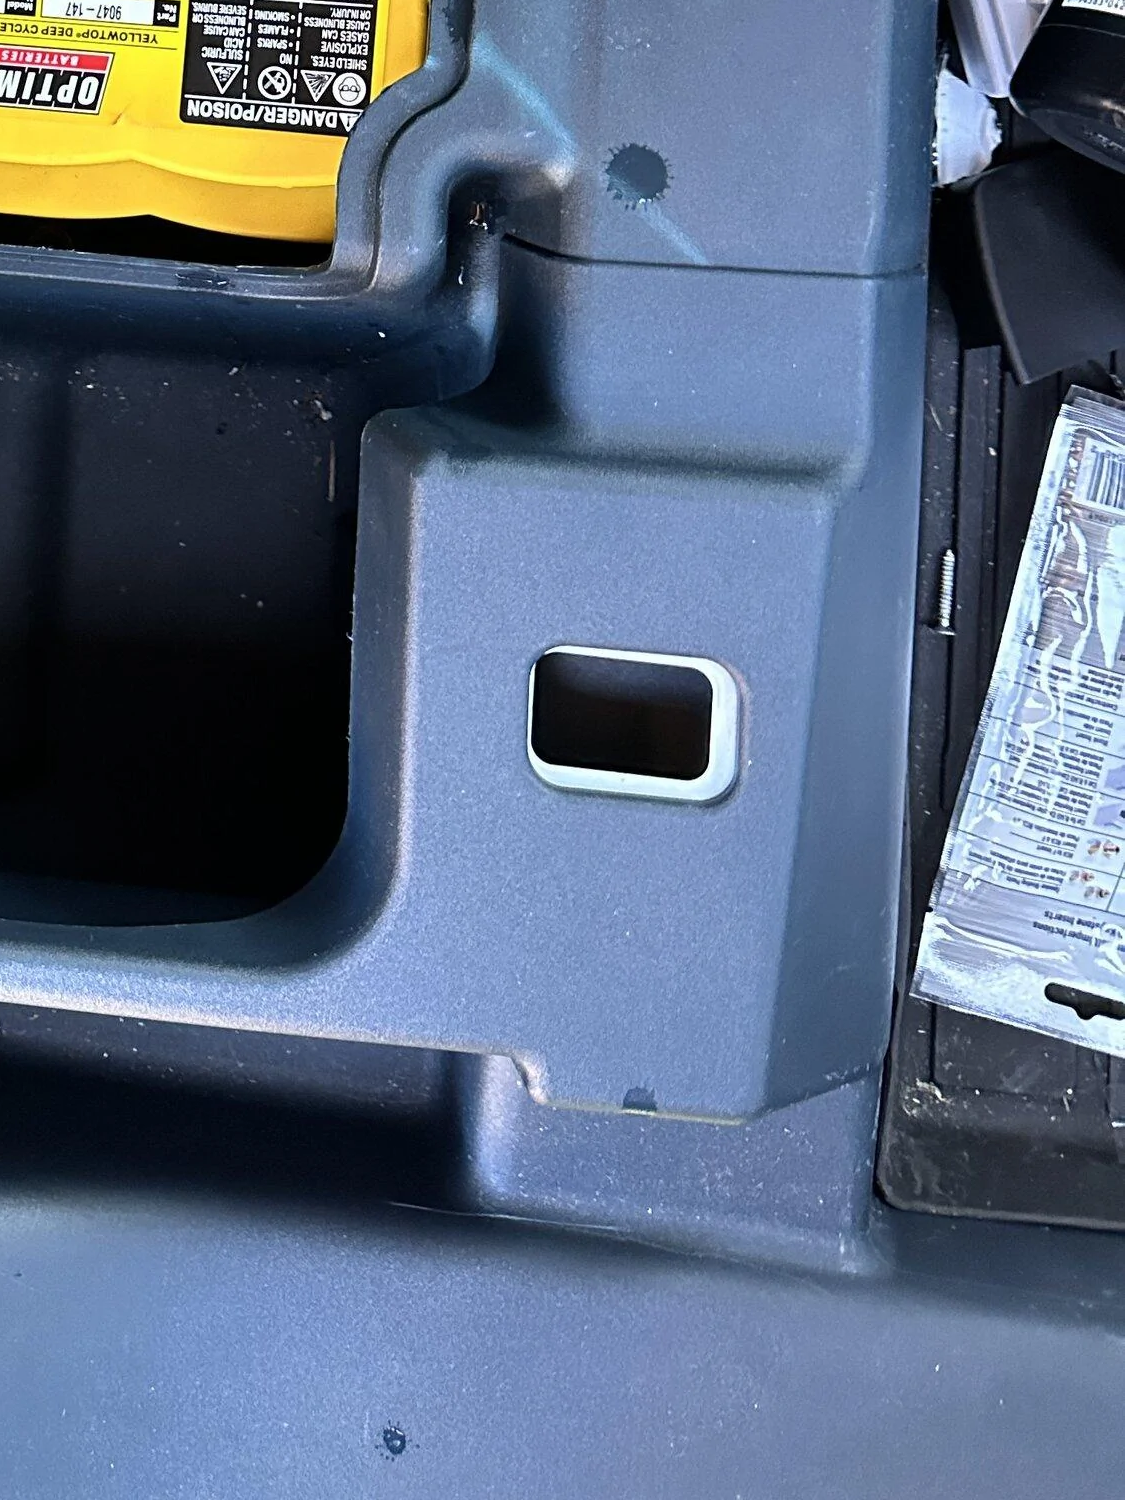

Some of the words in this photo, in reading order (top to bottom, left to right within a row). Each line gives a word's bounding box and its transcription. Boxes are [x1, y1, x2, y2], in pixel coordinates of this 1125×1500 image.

[6, 0, 33, 11] Model
[161, 3, 176, 12] No.
[191, 1, 218, 12] BURNS.
[218, 3, 246, 14] SEVERE
[156, 12, 176, 22] Part
[191, 12, 203, 22] OR
[254, 9, 289, 22] SMOKING
[329, 7, 359, 18] INJURY.
[359, 9, 370, 19] OR
[203, 13, 245, 26] BLINDNESS
[303, 16, 345, 28] BLINDNESS
[345, 19, 370, 30] CAUSE
[0, 22, 38, 34] CYCLE
[41, 25, 72, 36] DEEP
[203, 24, 228, 35] CAUSE
[229, 26, 245, 36] CAN
[257, 23, 288, 35] FLAMES
[321, 29, 337, 39] CAN
[340, 30, 369, 42] GASES
[223, 36, 243, 48] ACID
[256, 37, 287, 49] SPARKS
[320, 40, 368, 55] EXPLOSIVE
[0, 48, 79, 66] BATTERIES
[200, 46, 243, 59] SULFURIC
[279, 53, 292, 63] NO
[309, 55, 335, 67] EYES.
[335, 57, 366, 70] SHIELD
[186, 98, 337, 127] DANGER/POISON
